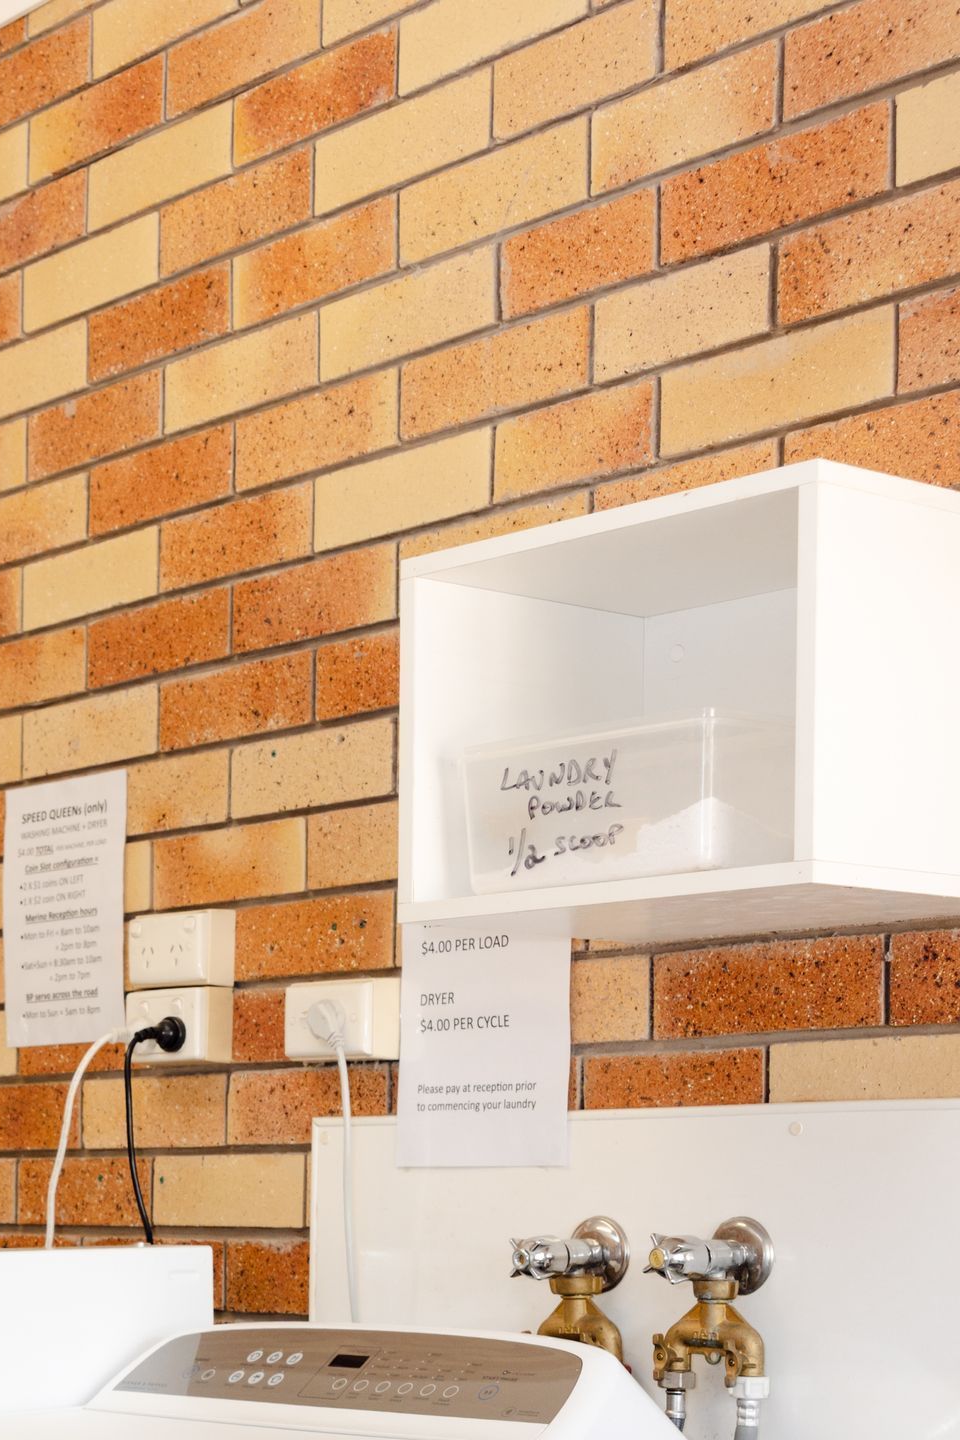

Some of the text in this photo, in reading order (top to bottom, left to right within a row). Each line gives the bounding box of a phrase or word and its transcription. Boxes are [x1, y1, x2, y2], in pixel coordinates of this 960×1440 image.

[500, 749, 617, 791] LAUNDRY
[22, 799, 107, 824] SPEED QUEENs (only)
[528, 791, 623, 820] POWDER
[553, 824, 624, 856] SCOOP
[422, 935, 509, 955] $4.00 PER LOAD
[420, 992, 455, 1007] DRYER
[420, 1015, 510, 1034] $4.00 PER CYCLE
[417, 1081, 537, 1095] Please pay at reception prior
[417, 1099, 537, 1112] to commencing your laundry
